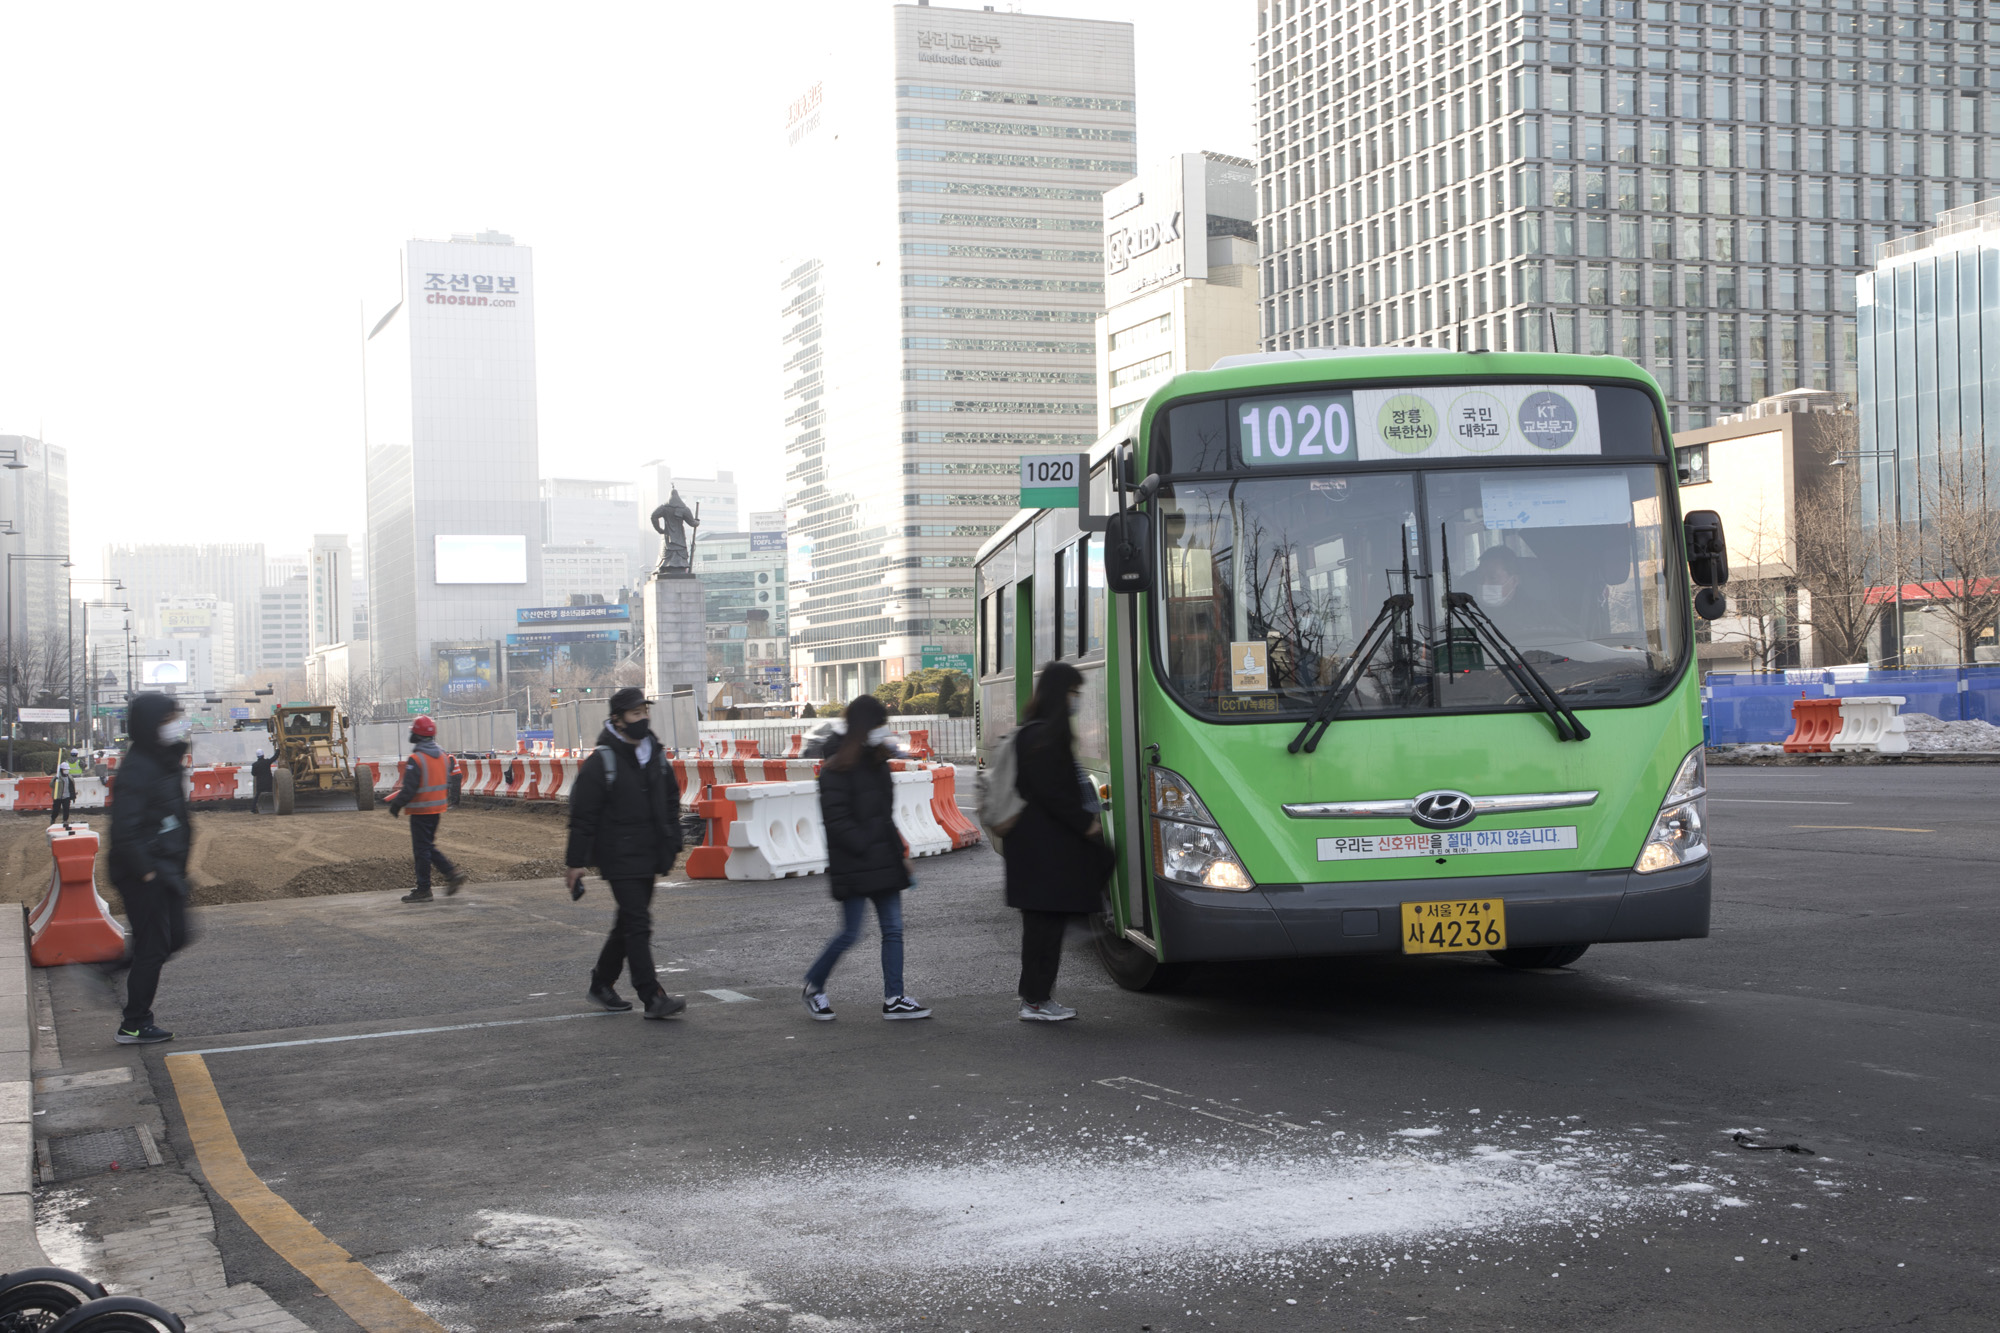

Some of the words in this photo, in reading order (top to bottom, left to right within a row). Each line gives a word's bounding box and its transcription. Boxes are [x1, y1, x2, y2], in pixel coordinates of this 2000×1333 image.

[918, 51, 967, 66] Methodist
[968, 56, 1002, 68] Center
[423, 272, 519, 294] 조선일보
[426, 292, 516, 308] chosun.com
[1392, 408, 1422, 425] 정릉
[1462, 406, 1492, 422] 국민
[1537, 406, 1556, 418] KT
[1242, 403, 1350, 457] 1020
[1383, 424, 1433, 440] (북한산)
[1459, 422, 1500, 438] 대학교
[1523, 420, 1575, 434] 교보문고
[1027, 460, 1074, 482] 1020
[529, 610, 558, 619] 신한은행
[1335, 839, 1374, 854] 우리는
[1377, 834, 1443, 852] 신호위반을
[1447, 832, 1473, 849] 절대
[1476, 832, 1502, 847] 하지
[1506, 828, 1560, 845] 않습니다.
